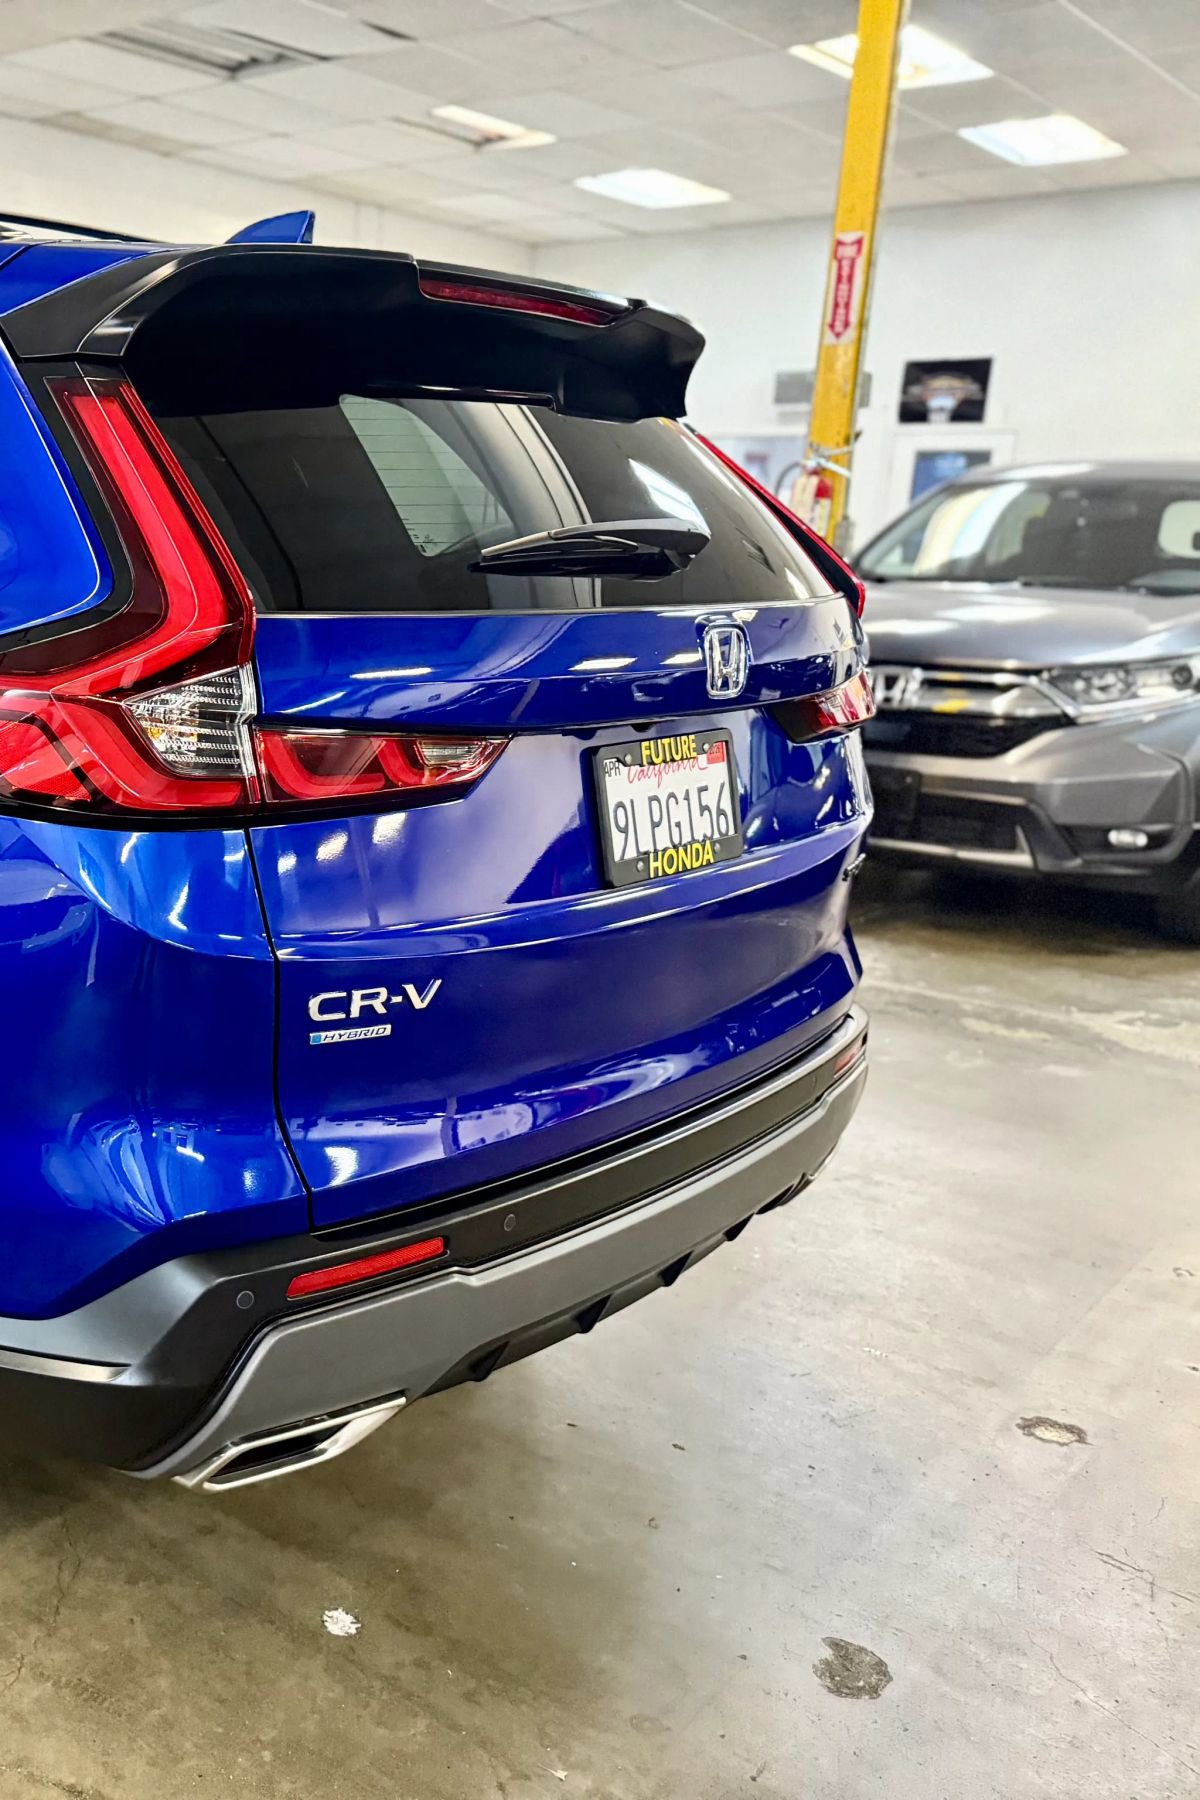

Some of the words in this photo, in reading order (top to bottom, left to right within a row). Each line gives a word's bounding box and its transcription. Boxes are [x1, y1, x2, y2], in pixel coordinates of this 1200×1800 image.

[641, 735, 698, 765] FUTURE
[604, 761, 621, 777] APR
[613, 781, 730, 860] 9LPG156
[650, 840, 714, 878] HONDA
[308, 979, 443, 1022] CR-V
[323, 1027, 387, 1042] HYBRID
